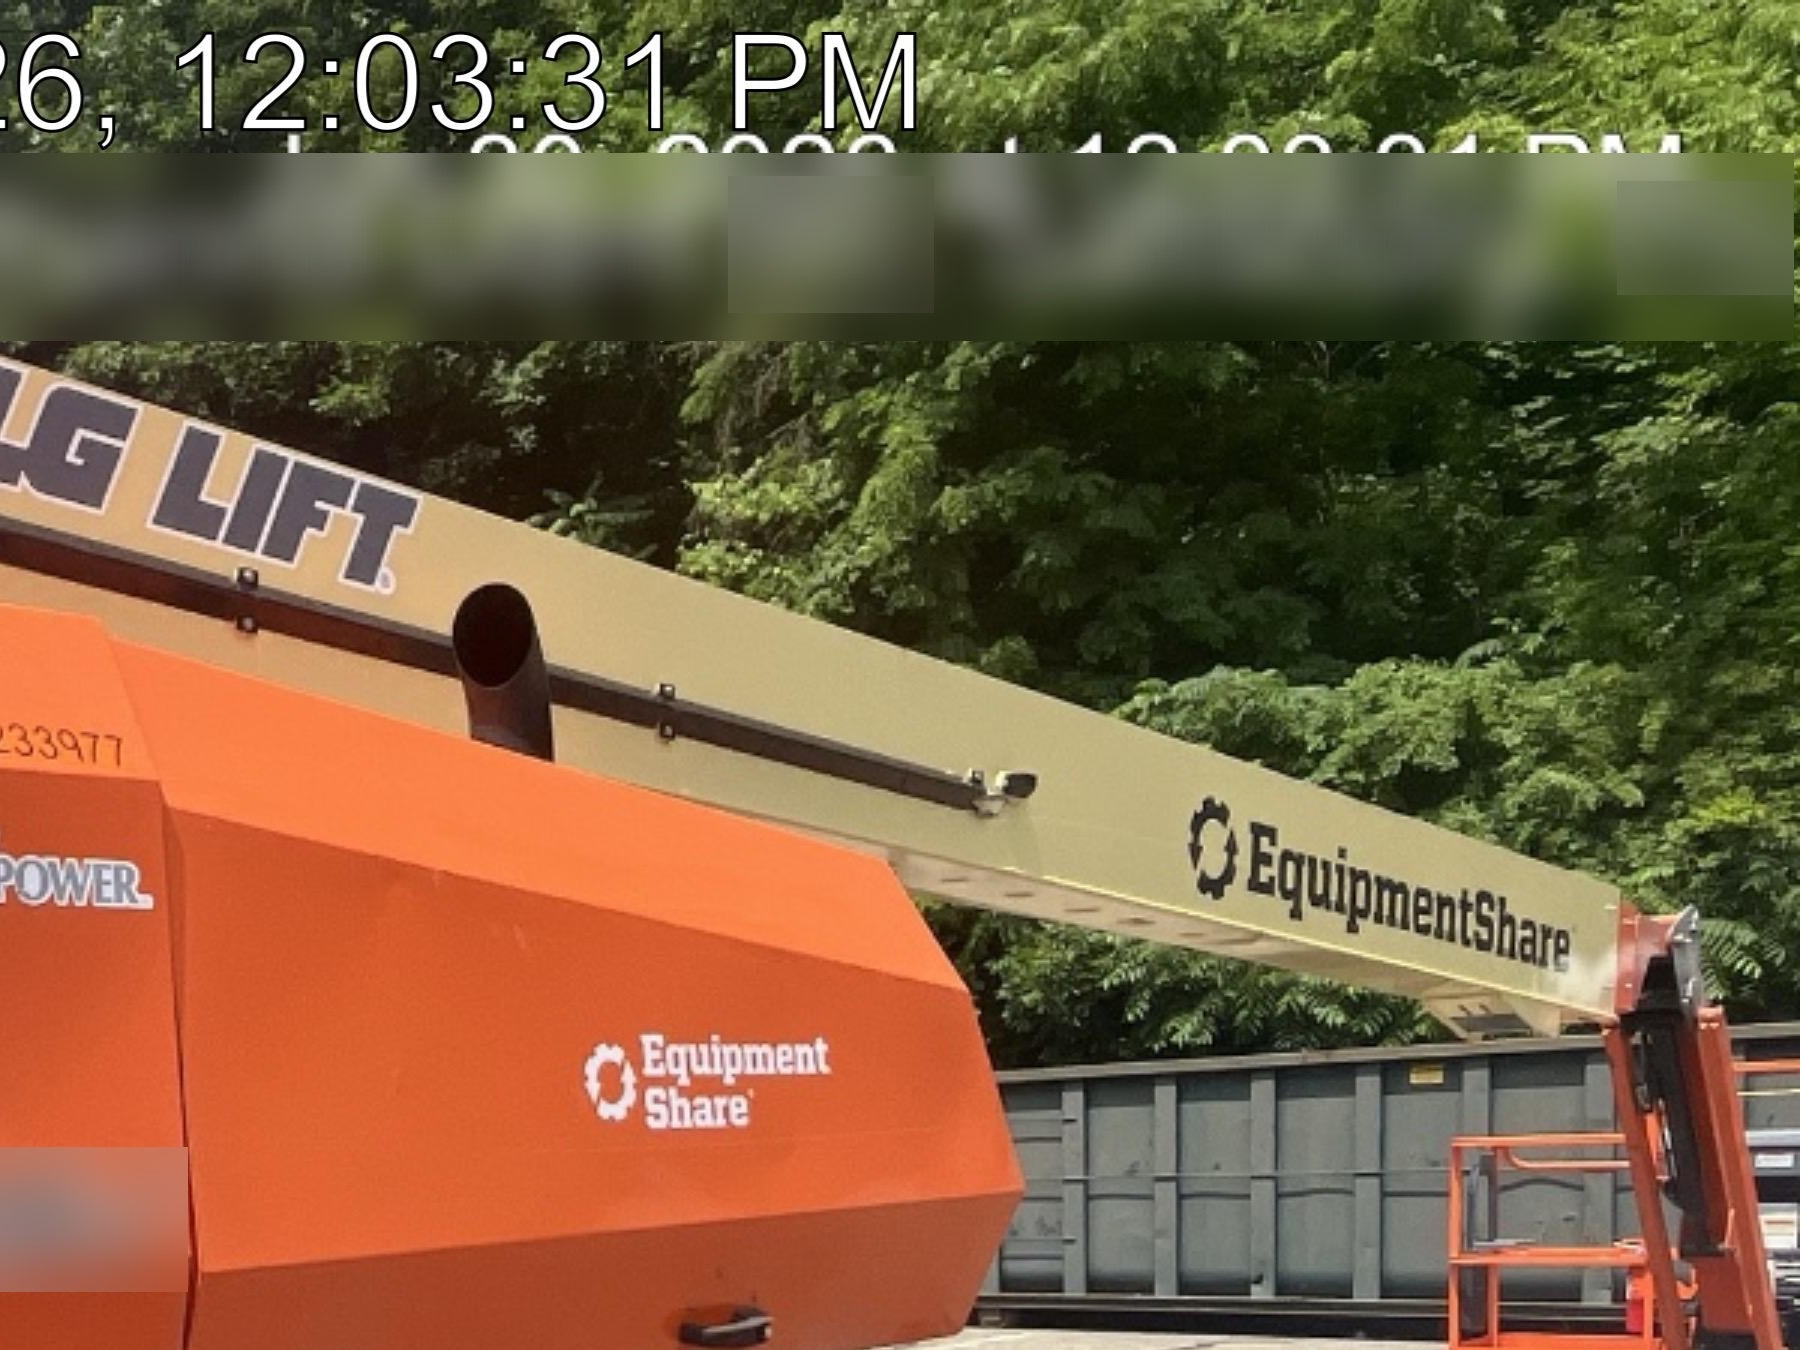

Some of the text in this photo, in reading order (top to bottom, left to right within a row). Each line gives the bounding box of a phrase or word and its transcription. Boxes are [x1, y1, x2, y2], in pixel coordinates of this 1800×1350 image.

[146, 418, 422, 594] LIFT
[1247, 820, 1571, 972] EquipmentShare
[639, 1033, 832, 1087] Equipment
[643, 1086, 749, 1130] Share
